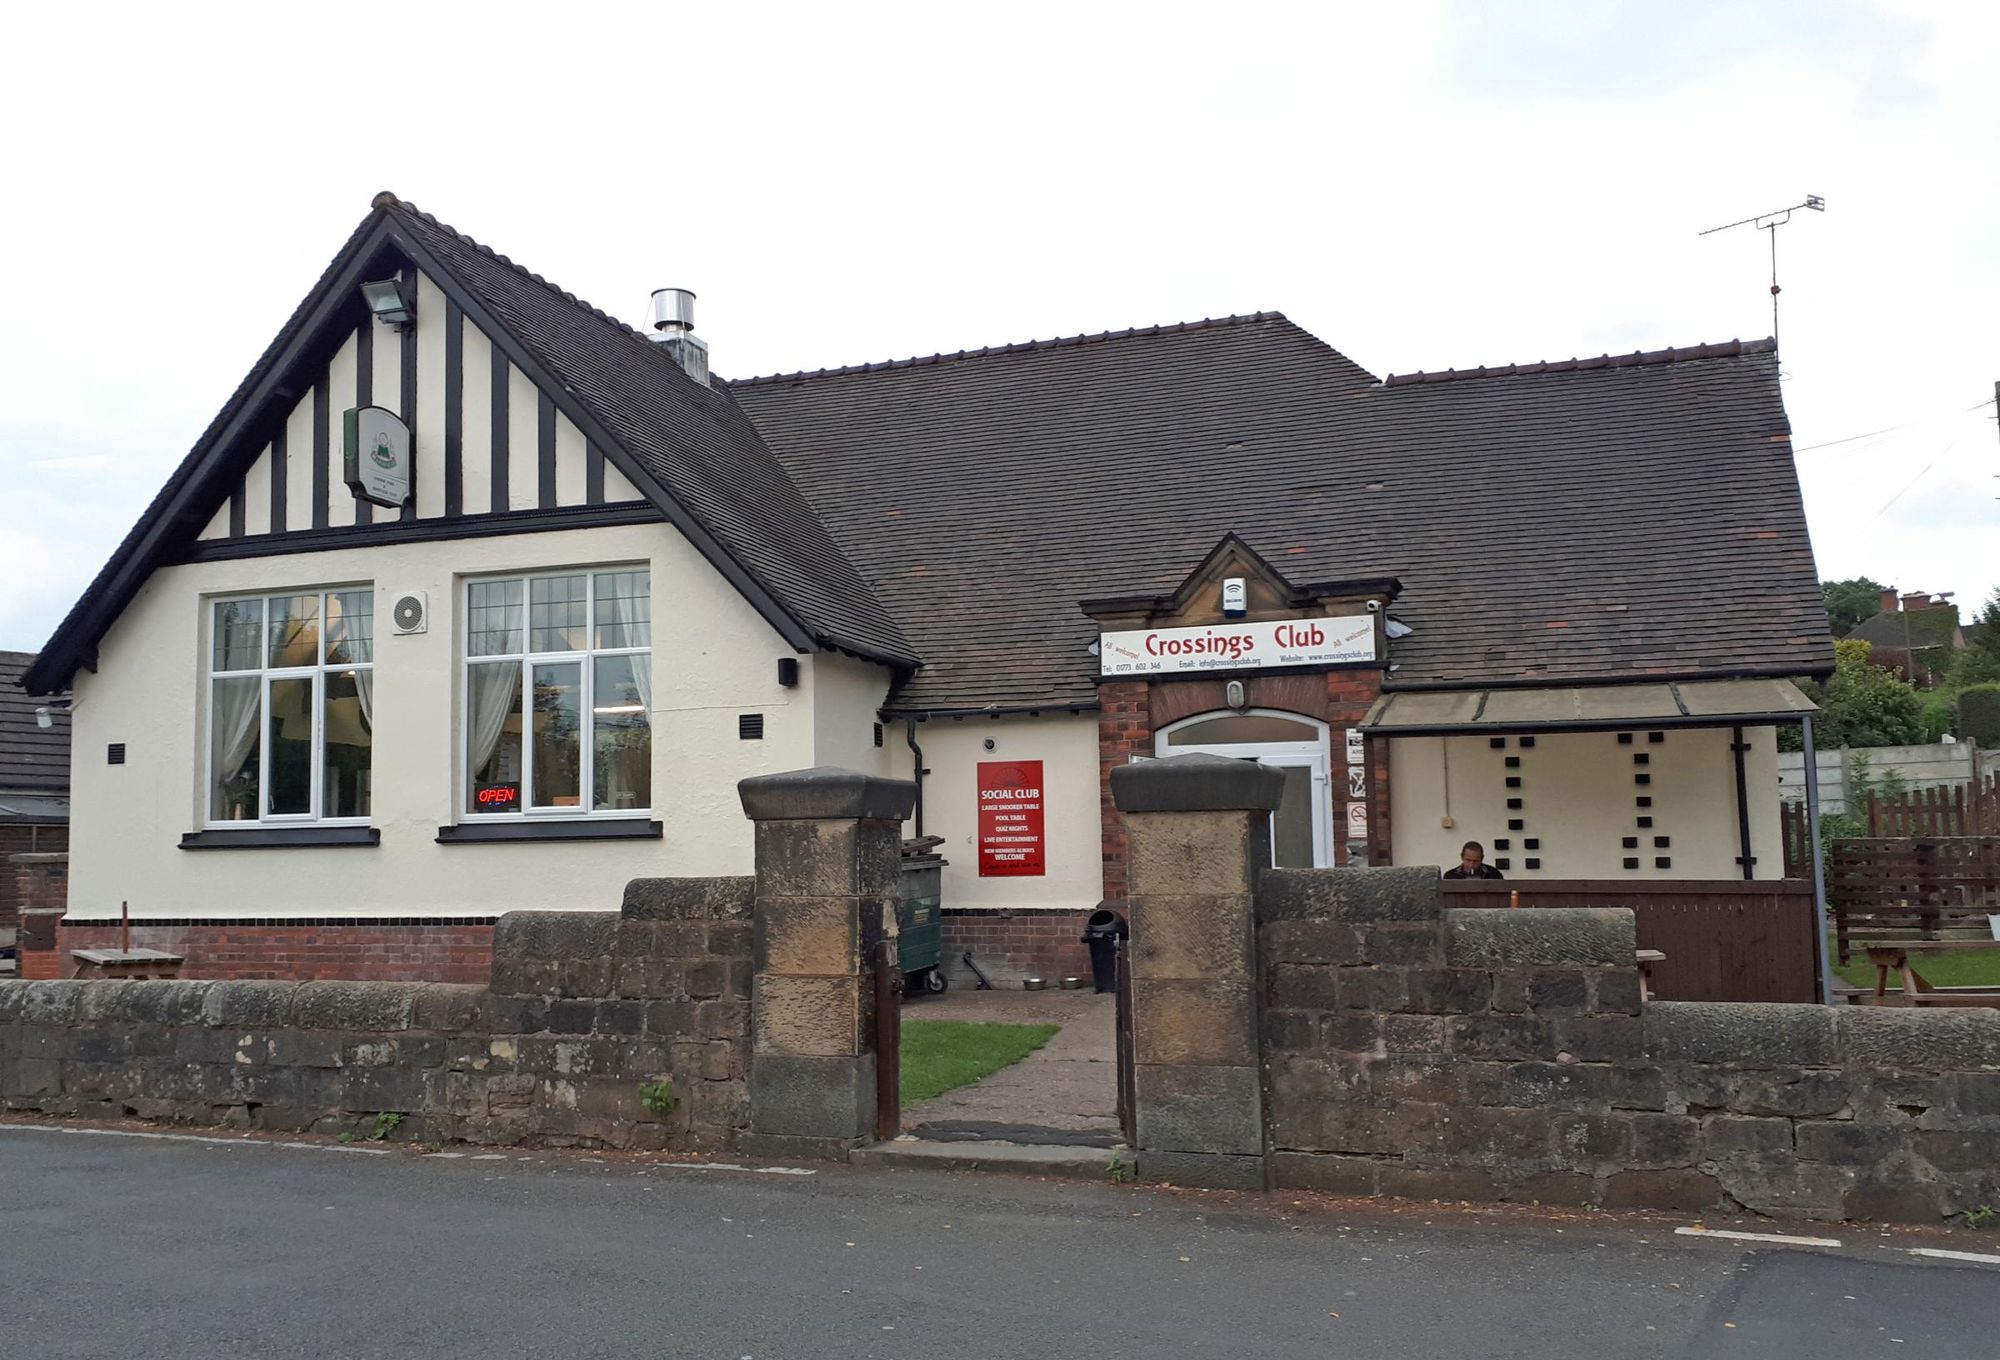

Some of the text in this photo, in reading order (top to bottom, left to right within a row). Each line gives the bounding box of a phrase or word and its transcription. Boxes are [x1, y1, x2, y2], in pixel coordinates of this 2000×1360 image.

[1145, 623, 1325, 660] Crossings Club
[1280, 650, 1373, 663] Website: www.crossingsclub.org
[1103, 661, 1161, 673] Tel: 01773 602 346
[1179, 660, 1195, 668] Email:
[479, 788, 514, 802] OPEN
[981, 789, 1040, 800] SOCIAL CLUB
[994, 853, 1026, 861] WELCOME
